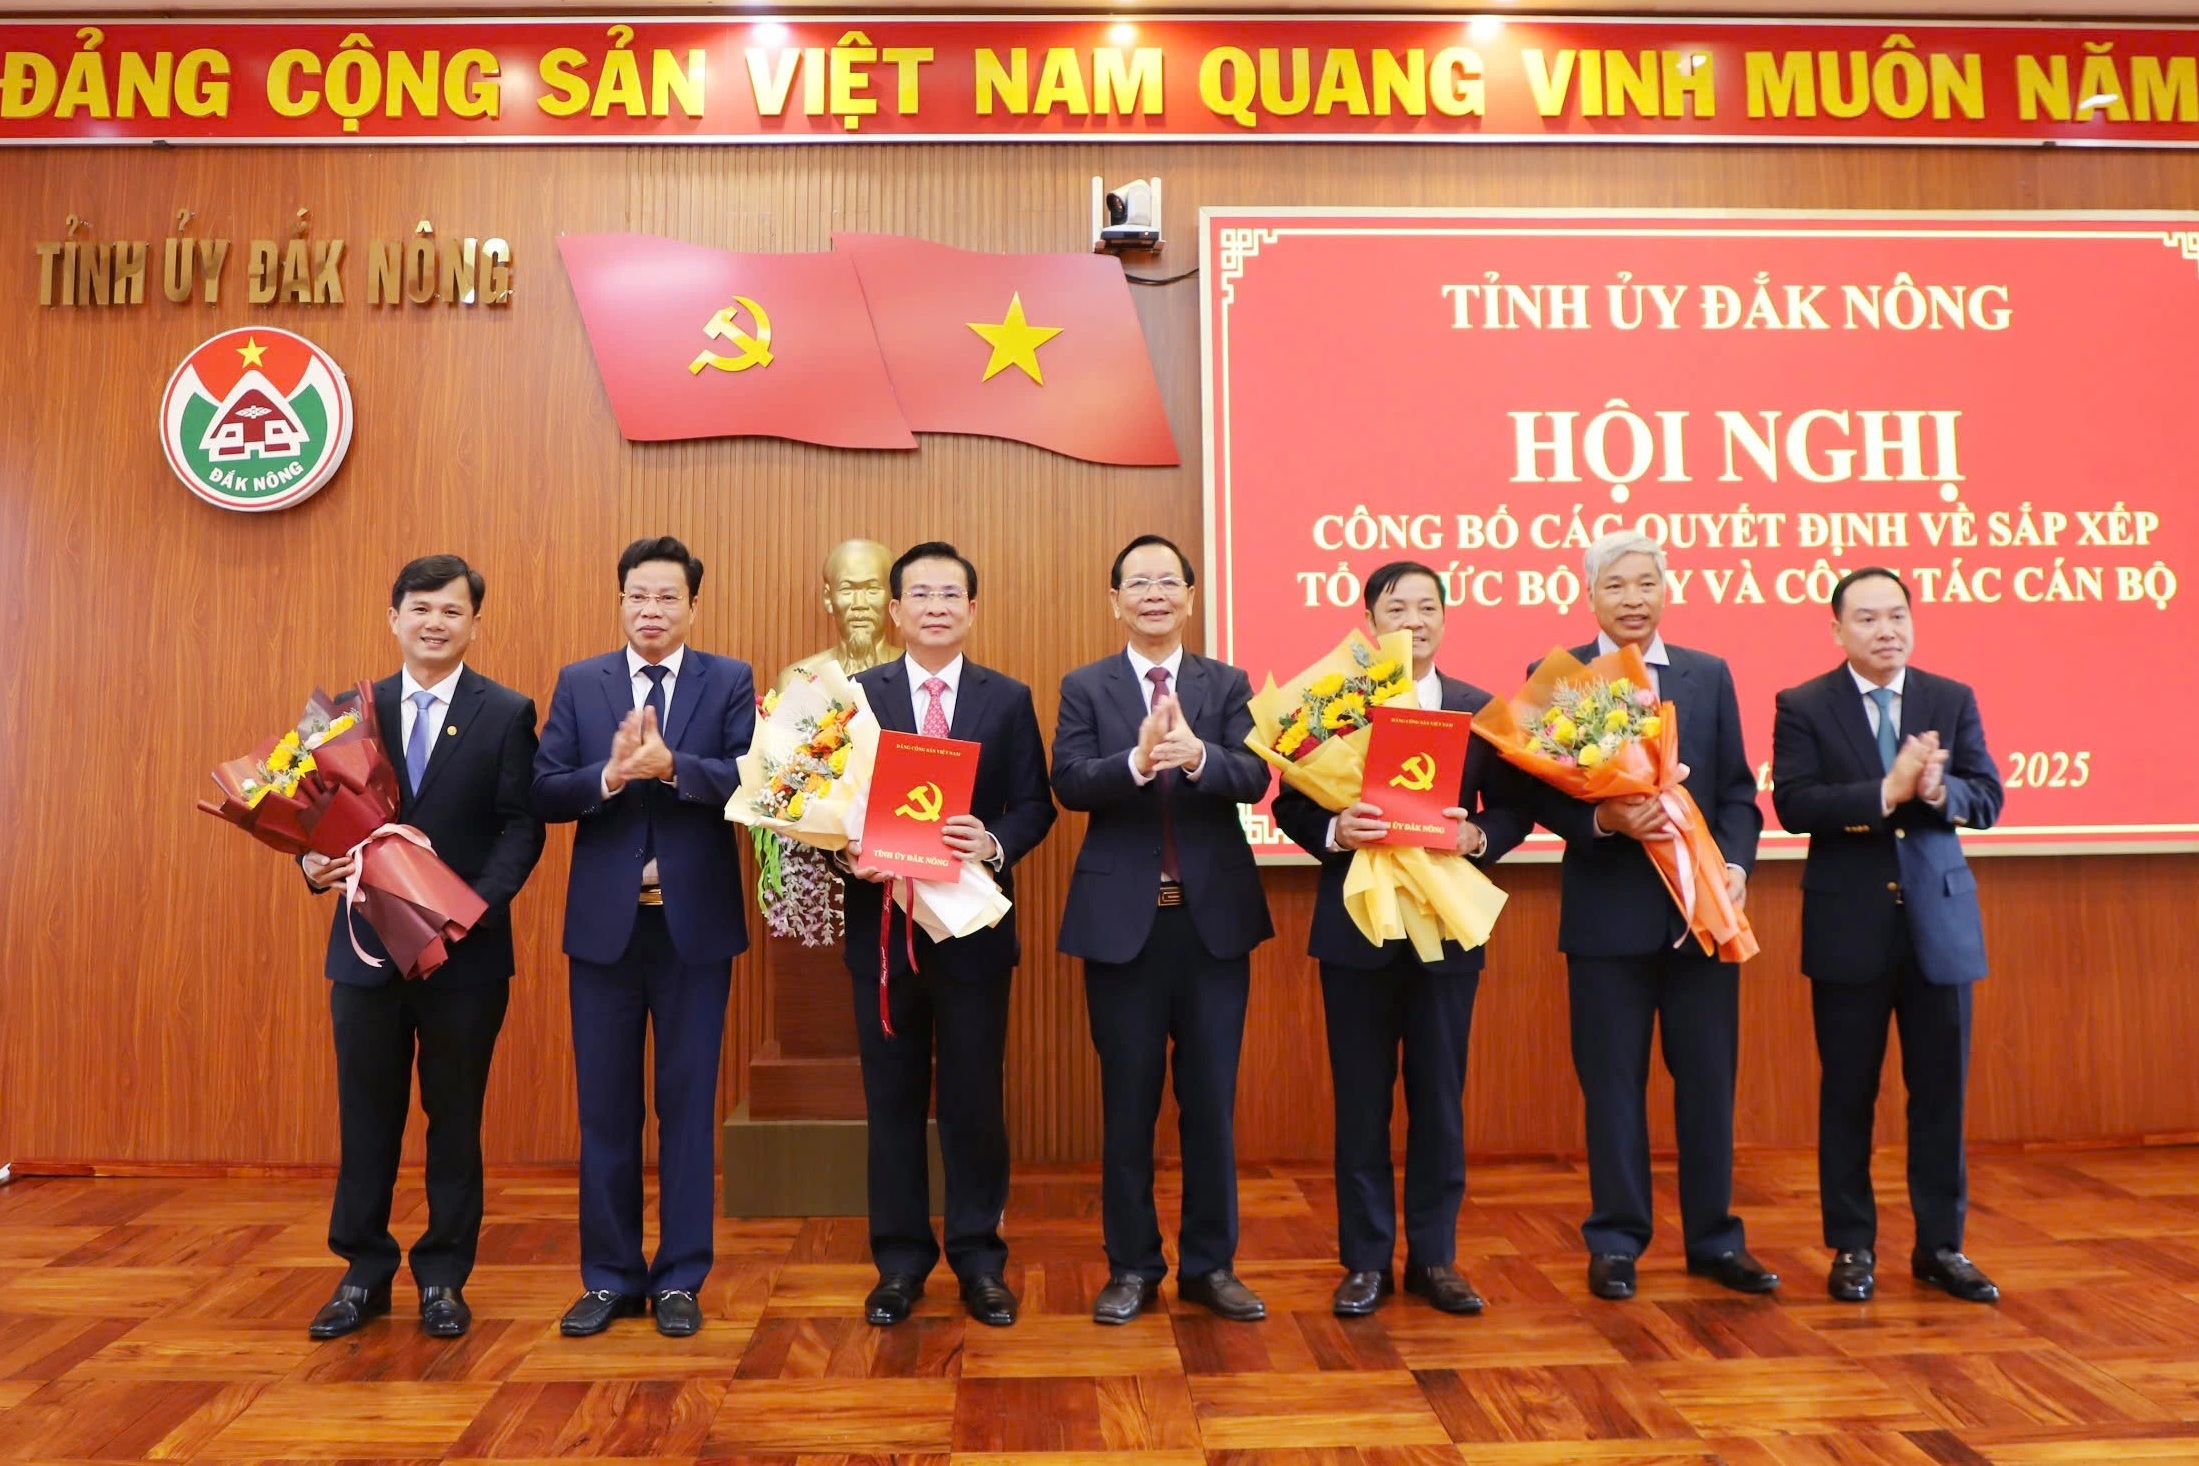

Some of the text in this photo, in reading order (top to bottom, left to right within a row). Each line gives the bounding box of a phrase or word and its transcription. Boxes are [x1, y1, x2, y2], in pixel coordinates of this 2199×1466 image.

[0, 24, 2198, 132] ĐẢNG CỘNG SẢN VIỆT NAM QUANG VINH MUÔN NĂM
[35, 213, 148, 305] TỈNH
[164, 208, 231, 304] ỦY
[367, 220, 511, 305] NÔNG
[1441, 270, 2013, 331] TỈNH ỦY ĐẮK NÔNG
[209, 461, 304, 491] ĐẮK NÔNG
[1507, 398, 1966, 503] HỘI NGHỊ
[1312, 504, 1444, 551] CÔNG
[1456, 503, 1520, 550] BỐ
[1634, 502, 1787, 556] QUYẾT
[1797, 512, 1909, 557] ĐỊNH
[1918, 502, 1978, 547] VỀ
[1987, 501, 2068, 547] SẮP
[2074, 501, 2159, 547] XẾP
[1516, 565, 1581, 615] BỘ
[1702, 558, 1766, 604] VÀ
[1775, 558, 1899, 605] CÔ
[1913, 557, 2002, 603] TÁC
[2013, 556, 2103, 603] CÁN
[2115, 561, 2177, 611] BỘ
[2004, 751, 2091, 788] 2025
